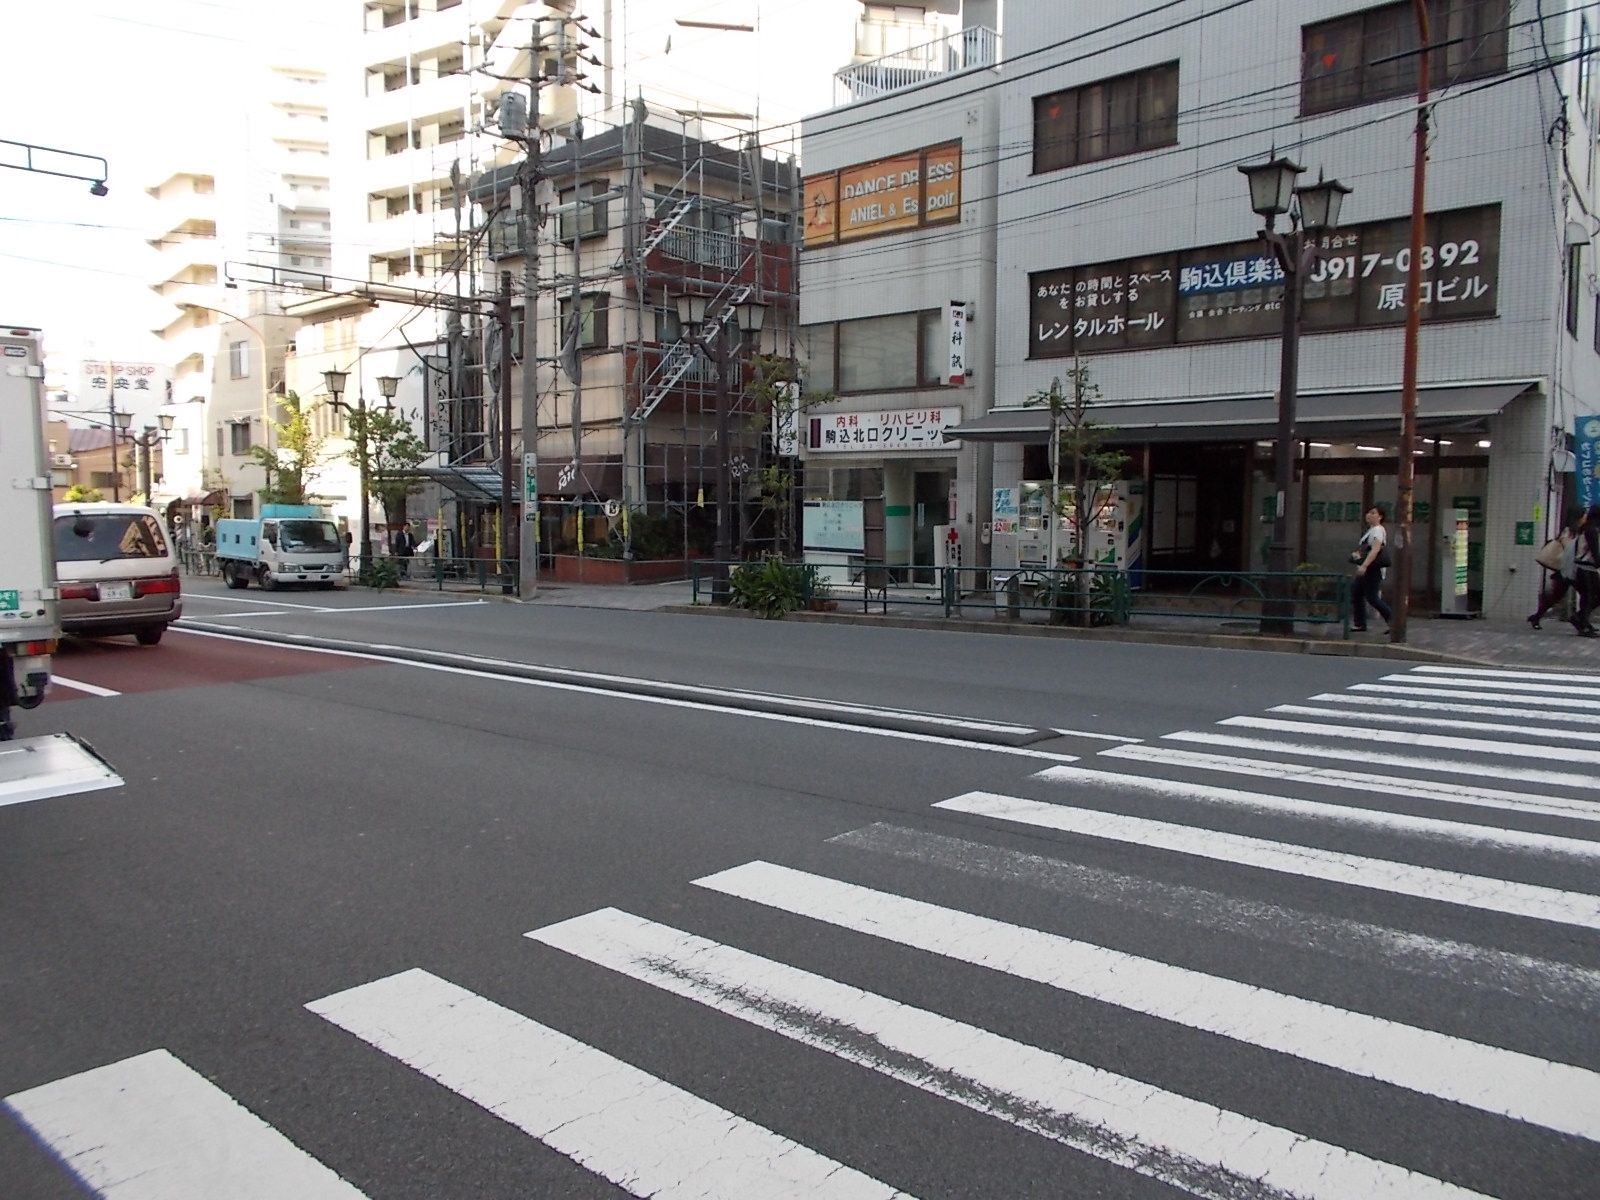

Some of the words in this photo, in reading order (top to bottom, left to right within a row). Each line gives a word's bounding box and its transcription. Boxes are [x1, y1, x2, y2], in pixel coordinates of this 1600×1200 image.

[844, 174, 896, 199] DANCE
[901, 161, 954, 189] DRESS
[850, 203, 885, 224] ANIEL
[888, 203, 896, 217] &
[903, 191, 955, 214] Espoir
[1039, 312, 1164, 341] レンタルホール
[127, 366, 156, 376] SHOP
[836, 415, 858, 428] 内科
[880, 411, 941, 425] リハビリ科
